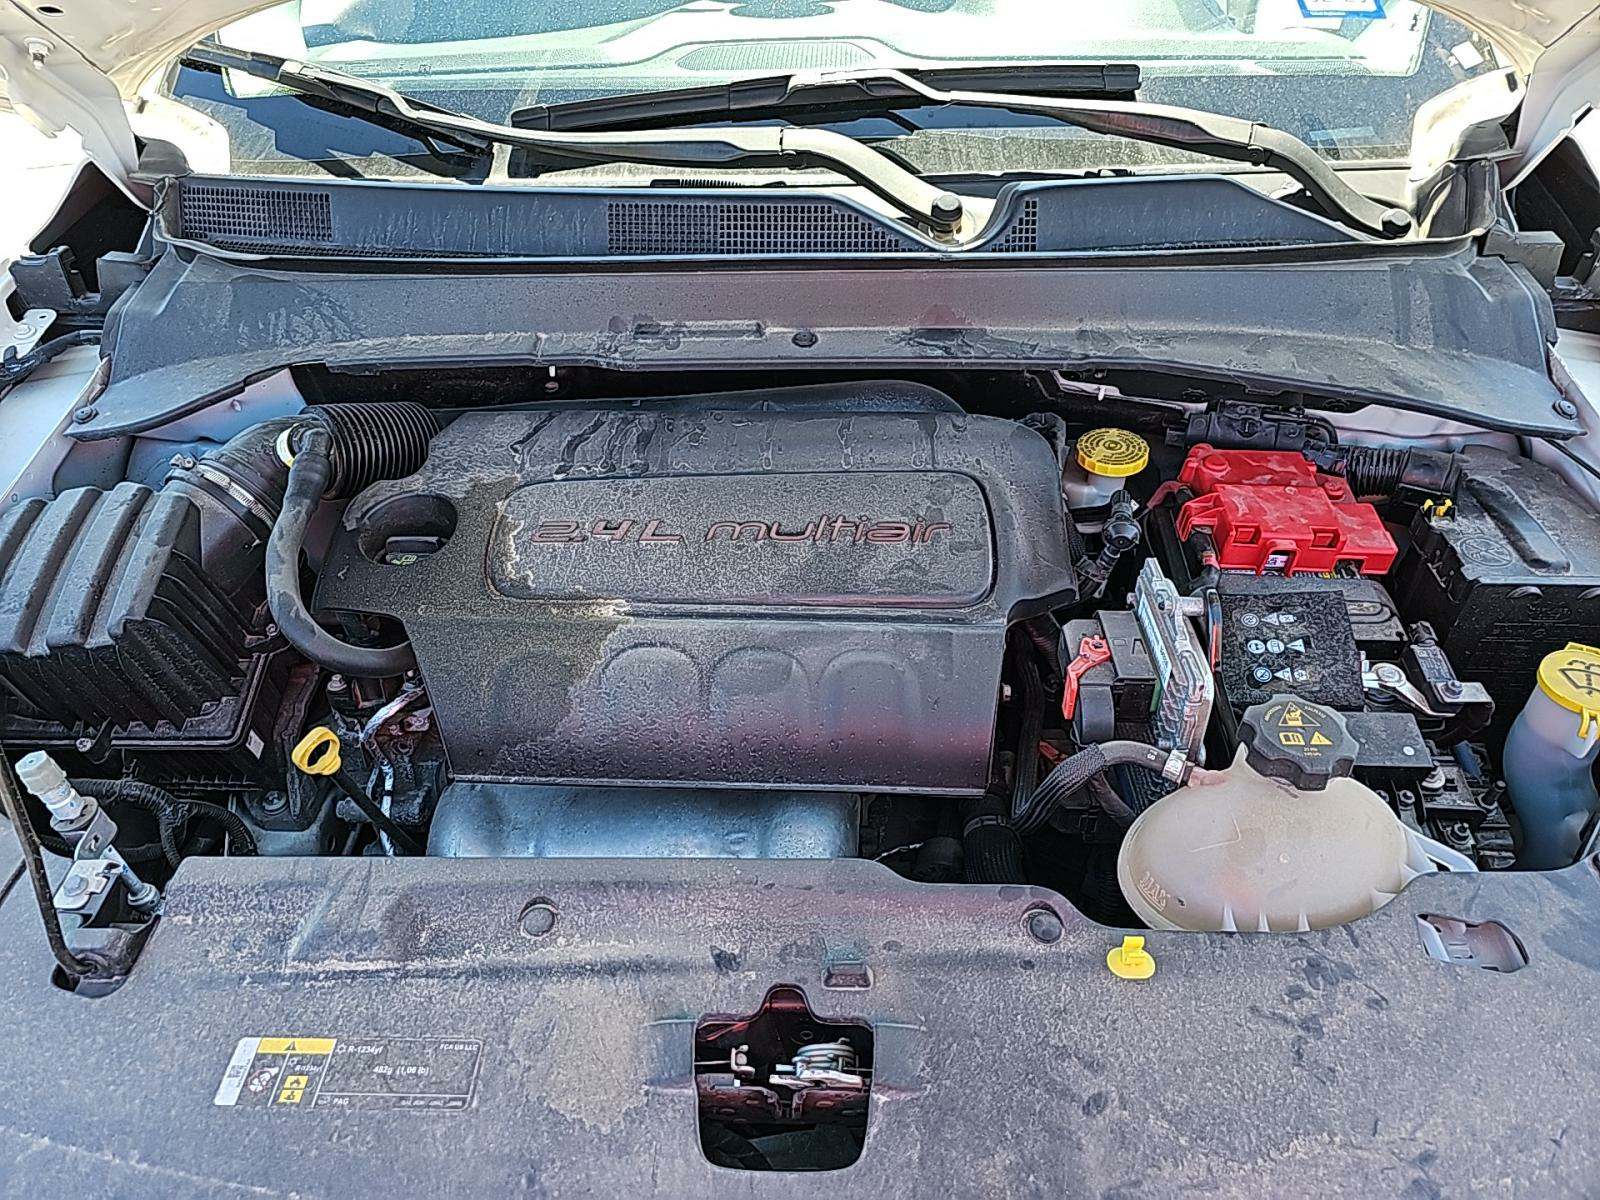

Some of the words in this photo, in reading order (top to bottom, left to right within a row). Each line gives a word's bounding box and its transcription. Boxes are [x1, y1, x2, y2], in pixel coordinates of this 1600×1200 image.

[530, 518, 683, 544] 2.4L
[704, 515, 952, 544] multiair
[348, 1044, 384, 1055] R-1234yf
